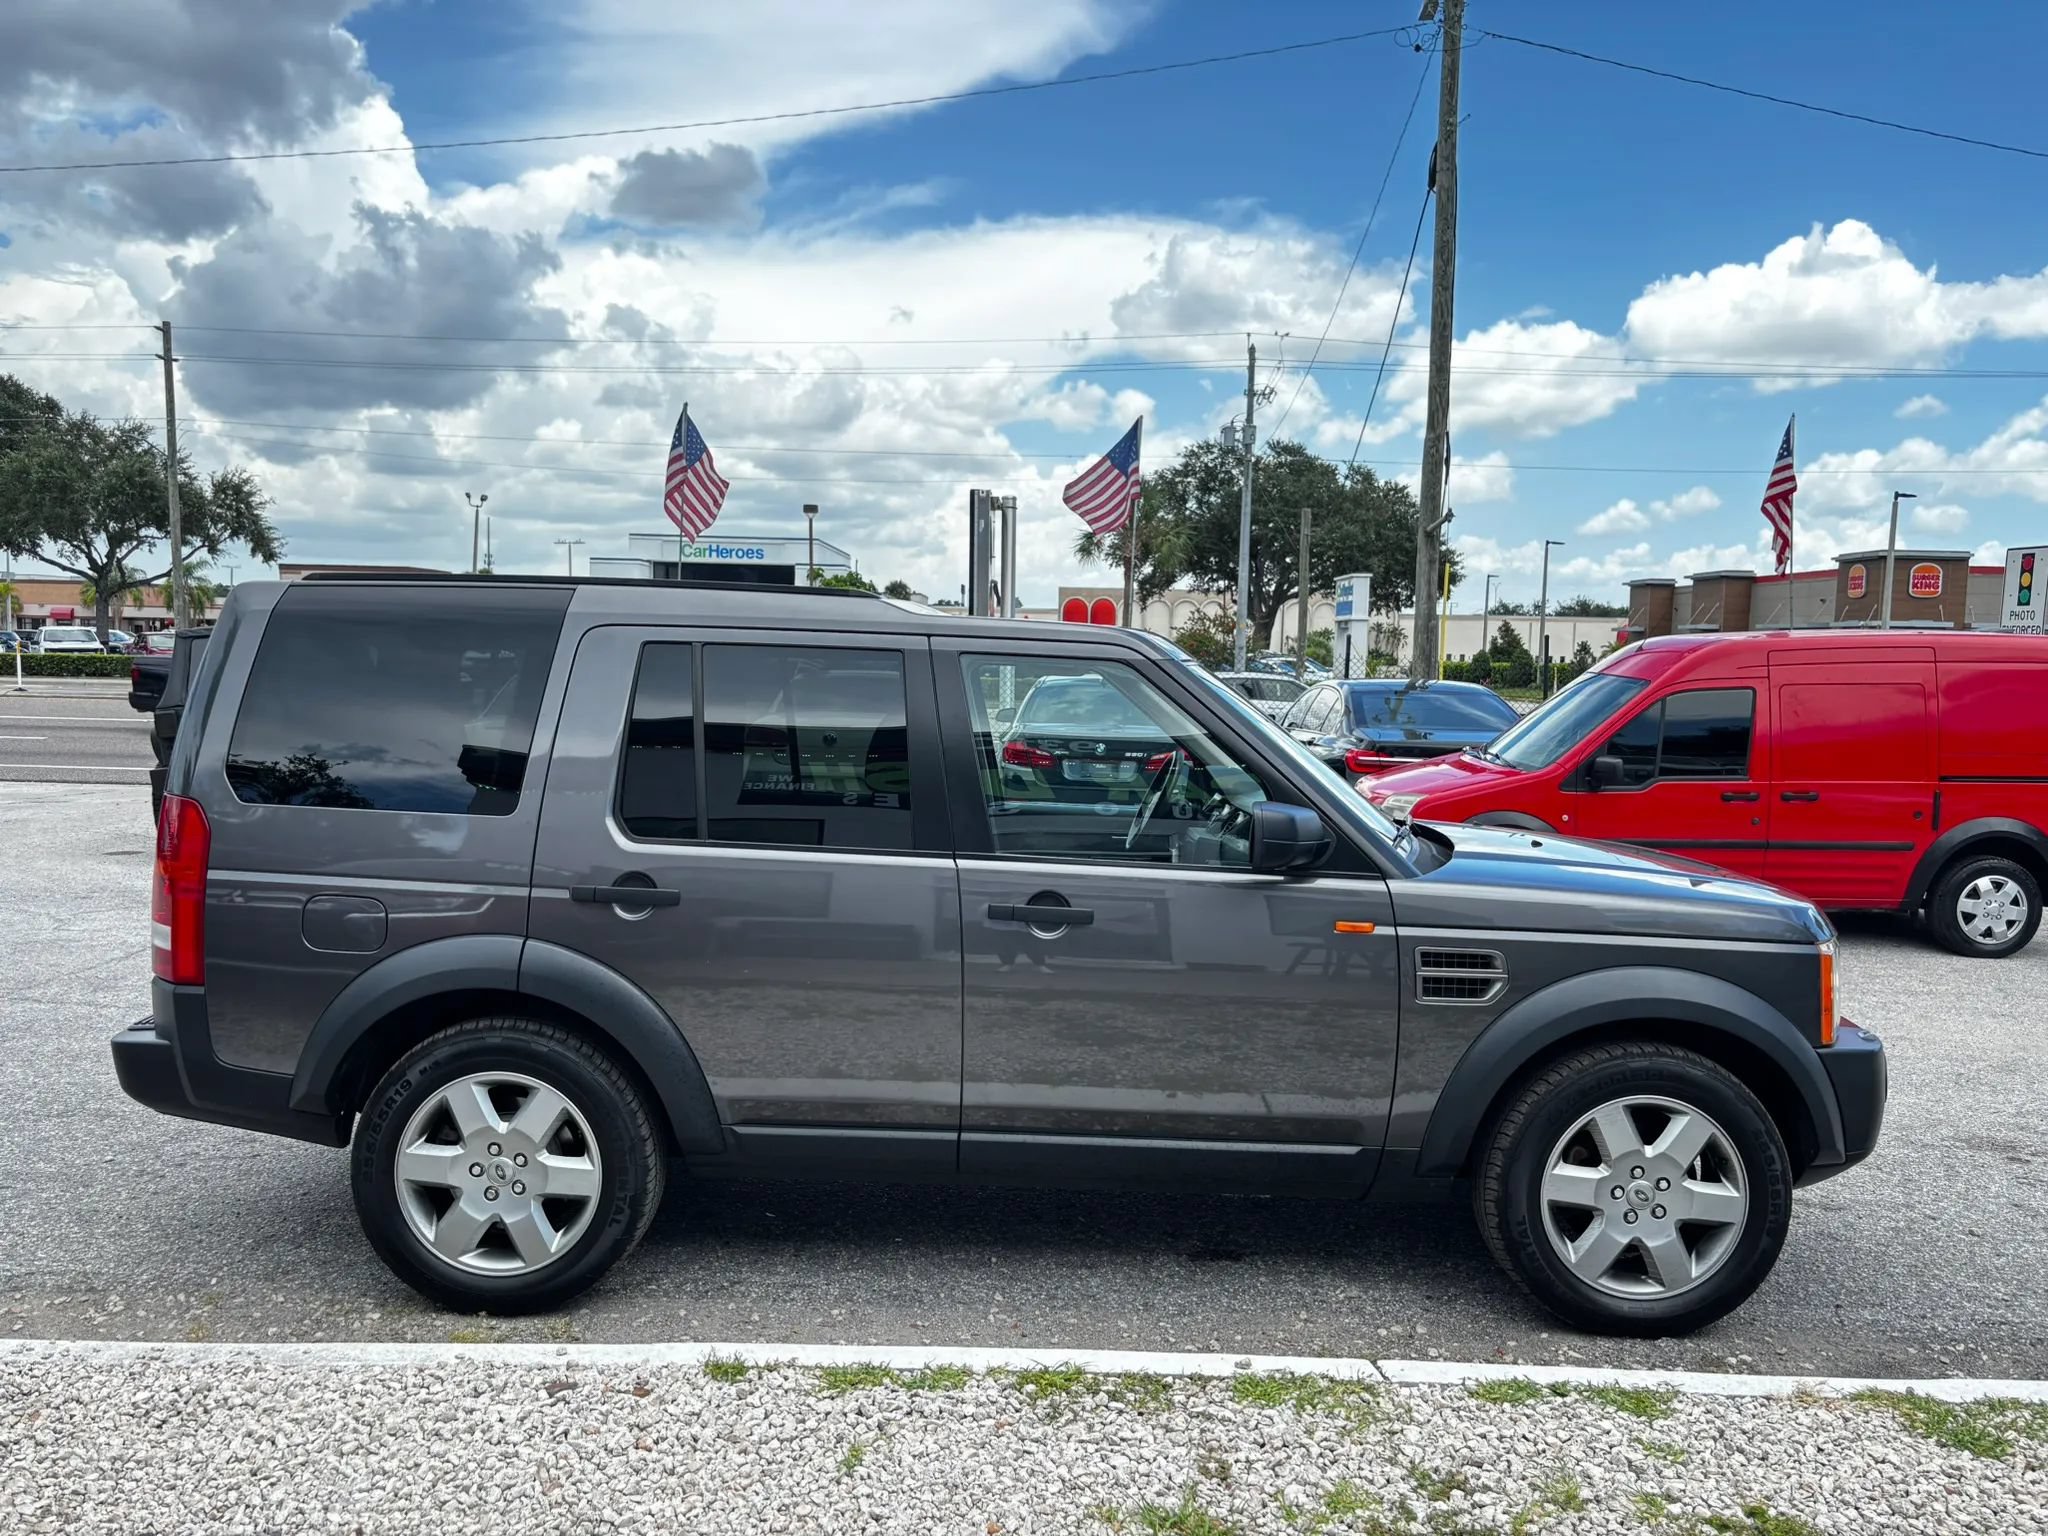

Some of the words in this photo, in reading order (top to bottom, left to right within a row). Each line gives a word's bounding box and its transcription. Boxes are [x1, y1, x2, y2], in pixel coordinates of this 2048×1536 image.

[681, 543, 765, 560] CarHeroes
[1911, 580, 1940, 590] KING
[2009, 610, 2036, 621] PHOTO
